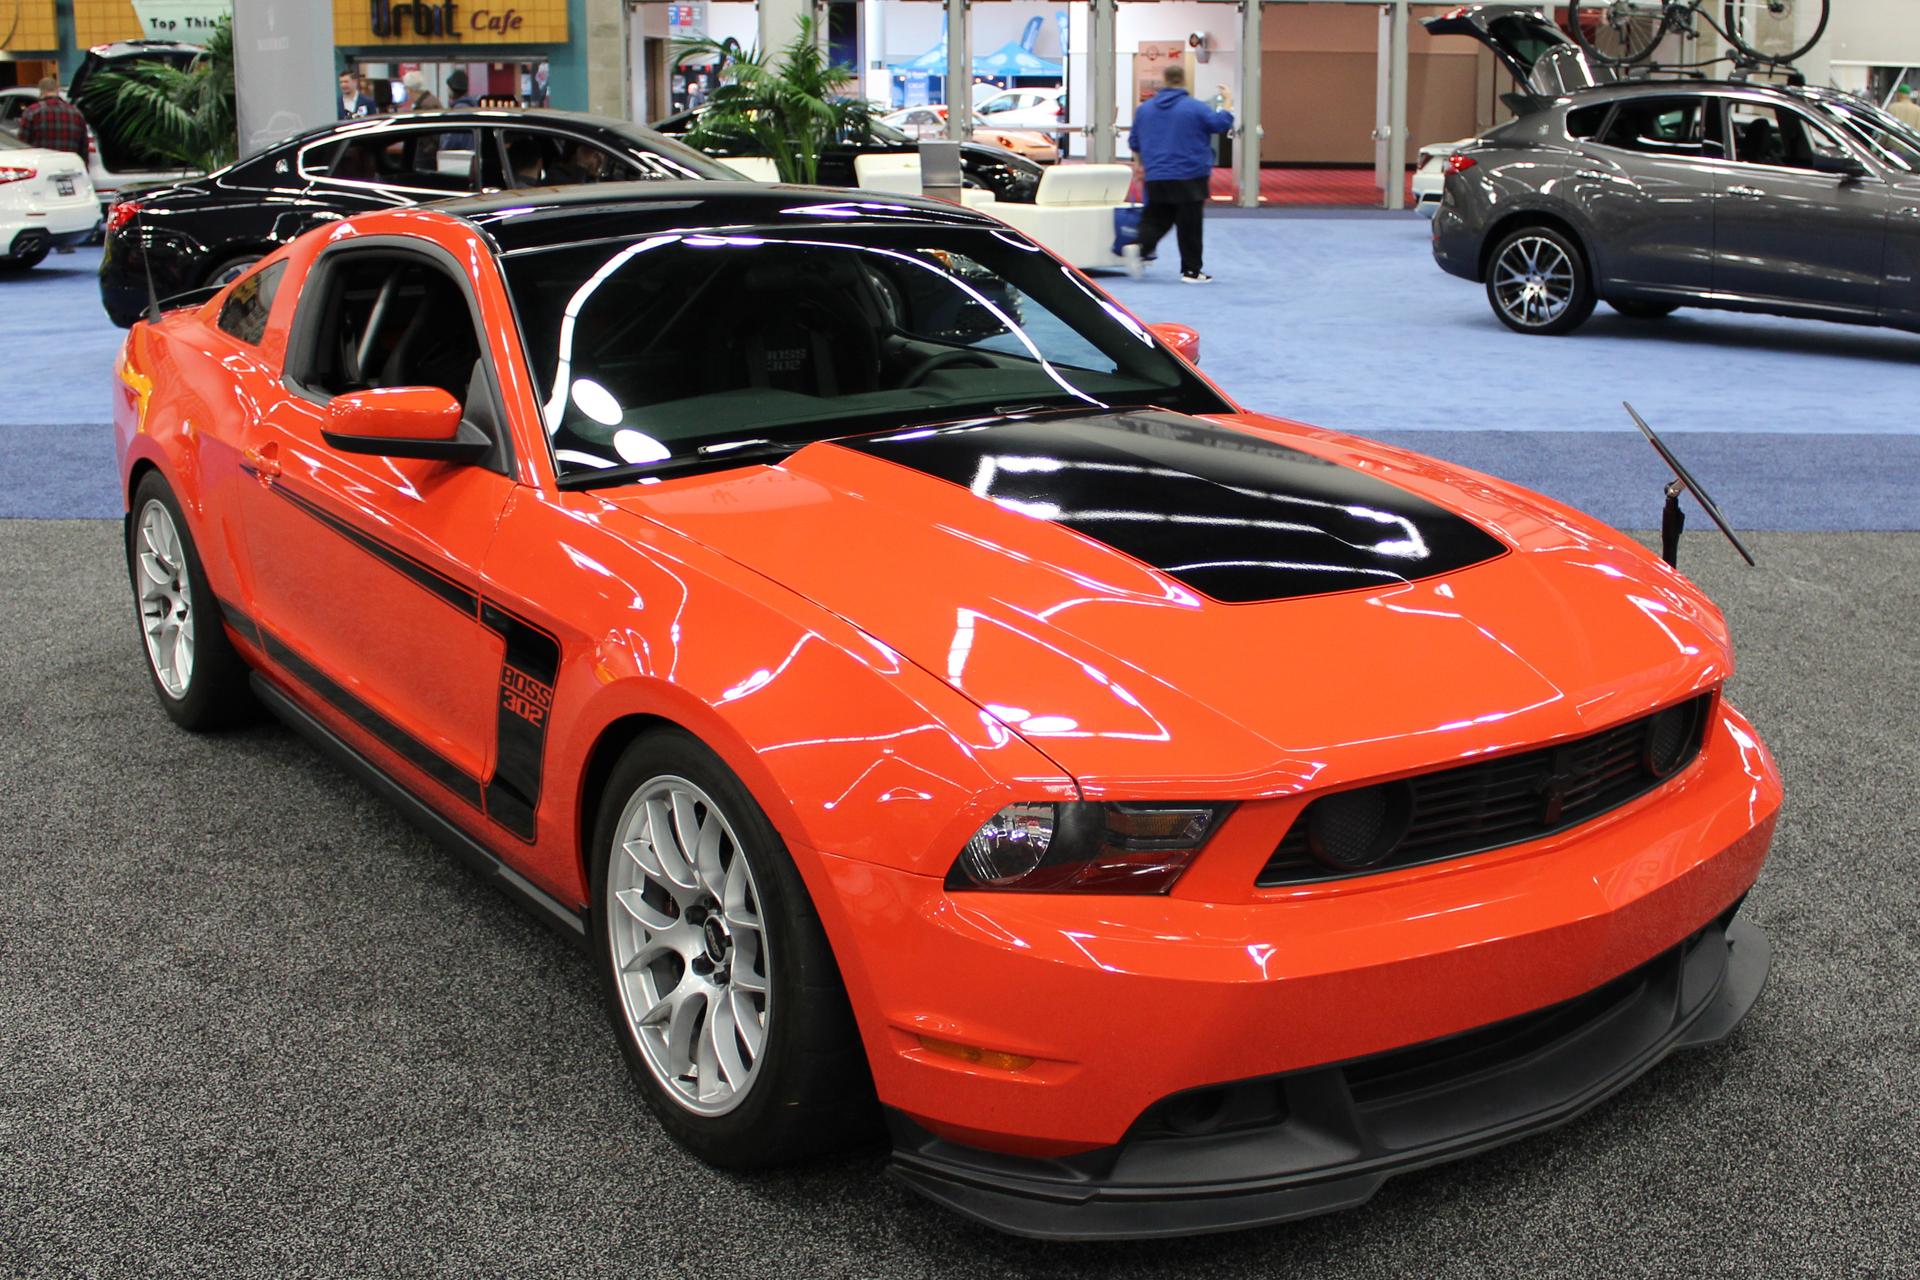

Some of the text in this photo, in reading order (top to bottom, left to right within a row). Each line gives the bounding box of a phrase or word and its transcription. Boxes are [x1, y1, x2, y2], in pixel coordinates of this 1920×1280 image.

[150, 17, 176, 31] Top
[371, 0, 523, 38] Orbit Cafe
[502, 666, 551, 709] BOSS
[502, 690, 543, 728] 302
